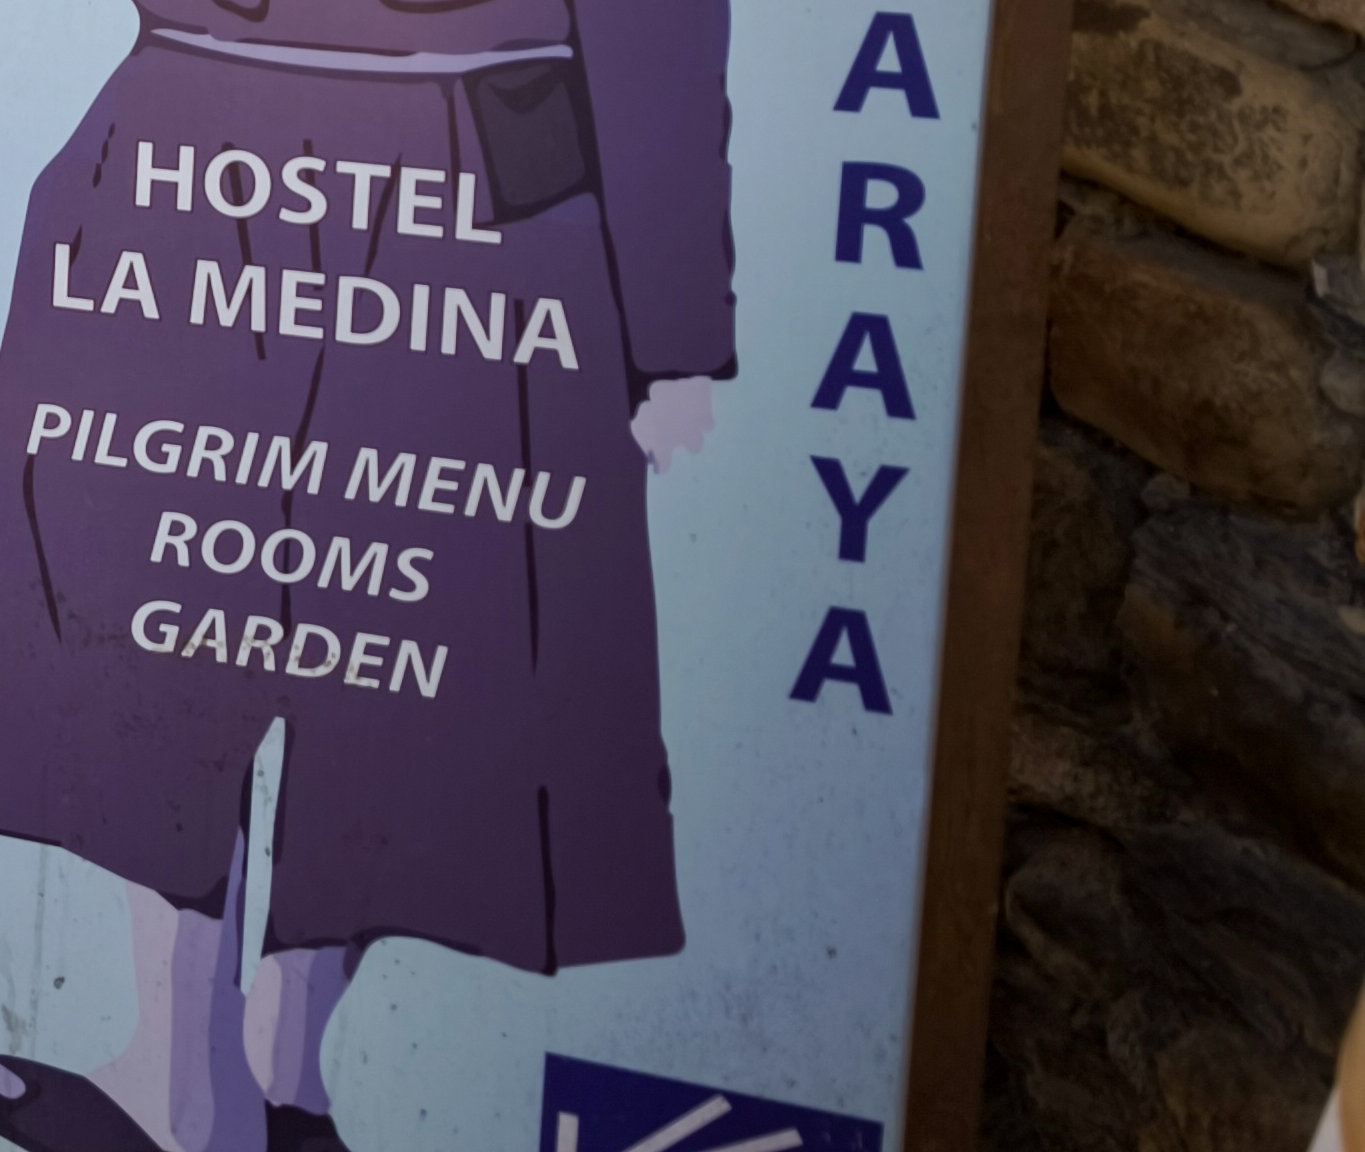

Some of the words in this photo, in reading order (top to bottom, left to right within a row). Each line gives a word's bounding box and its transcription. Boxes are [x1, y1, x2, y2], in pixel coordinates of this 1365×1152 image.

[134, 140, 502, 244] HOSTEL
[51, 242, 160, 320] LA
[189, 258, 579, 370] MEDINA
[26, 403, 329, 495] PILGRIM
[344, 447, 587, 529] MENU
[149, 511, 435, 602] ROOMS
[130, 600, 448, 699] GARDEN
